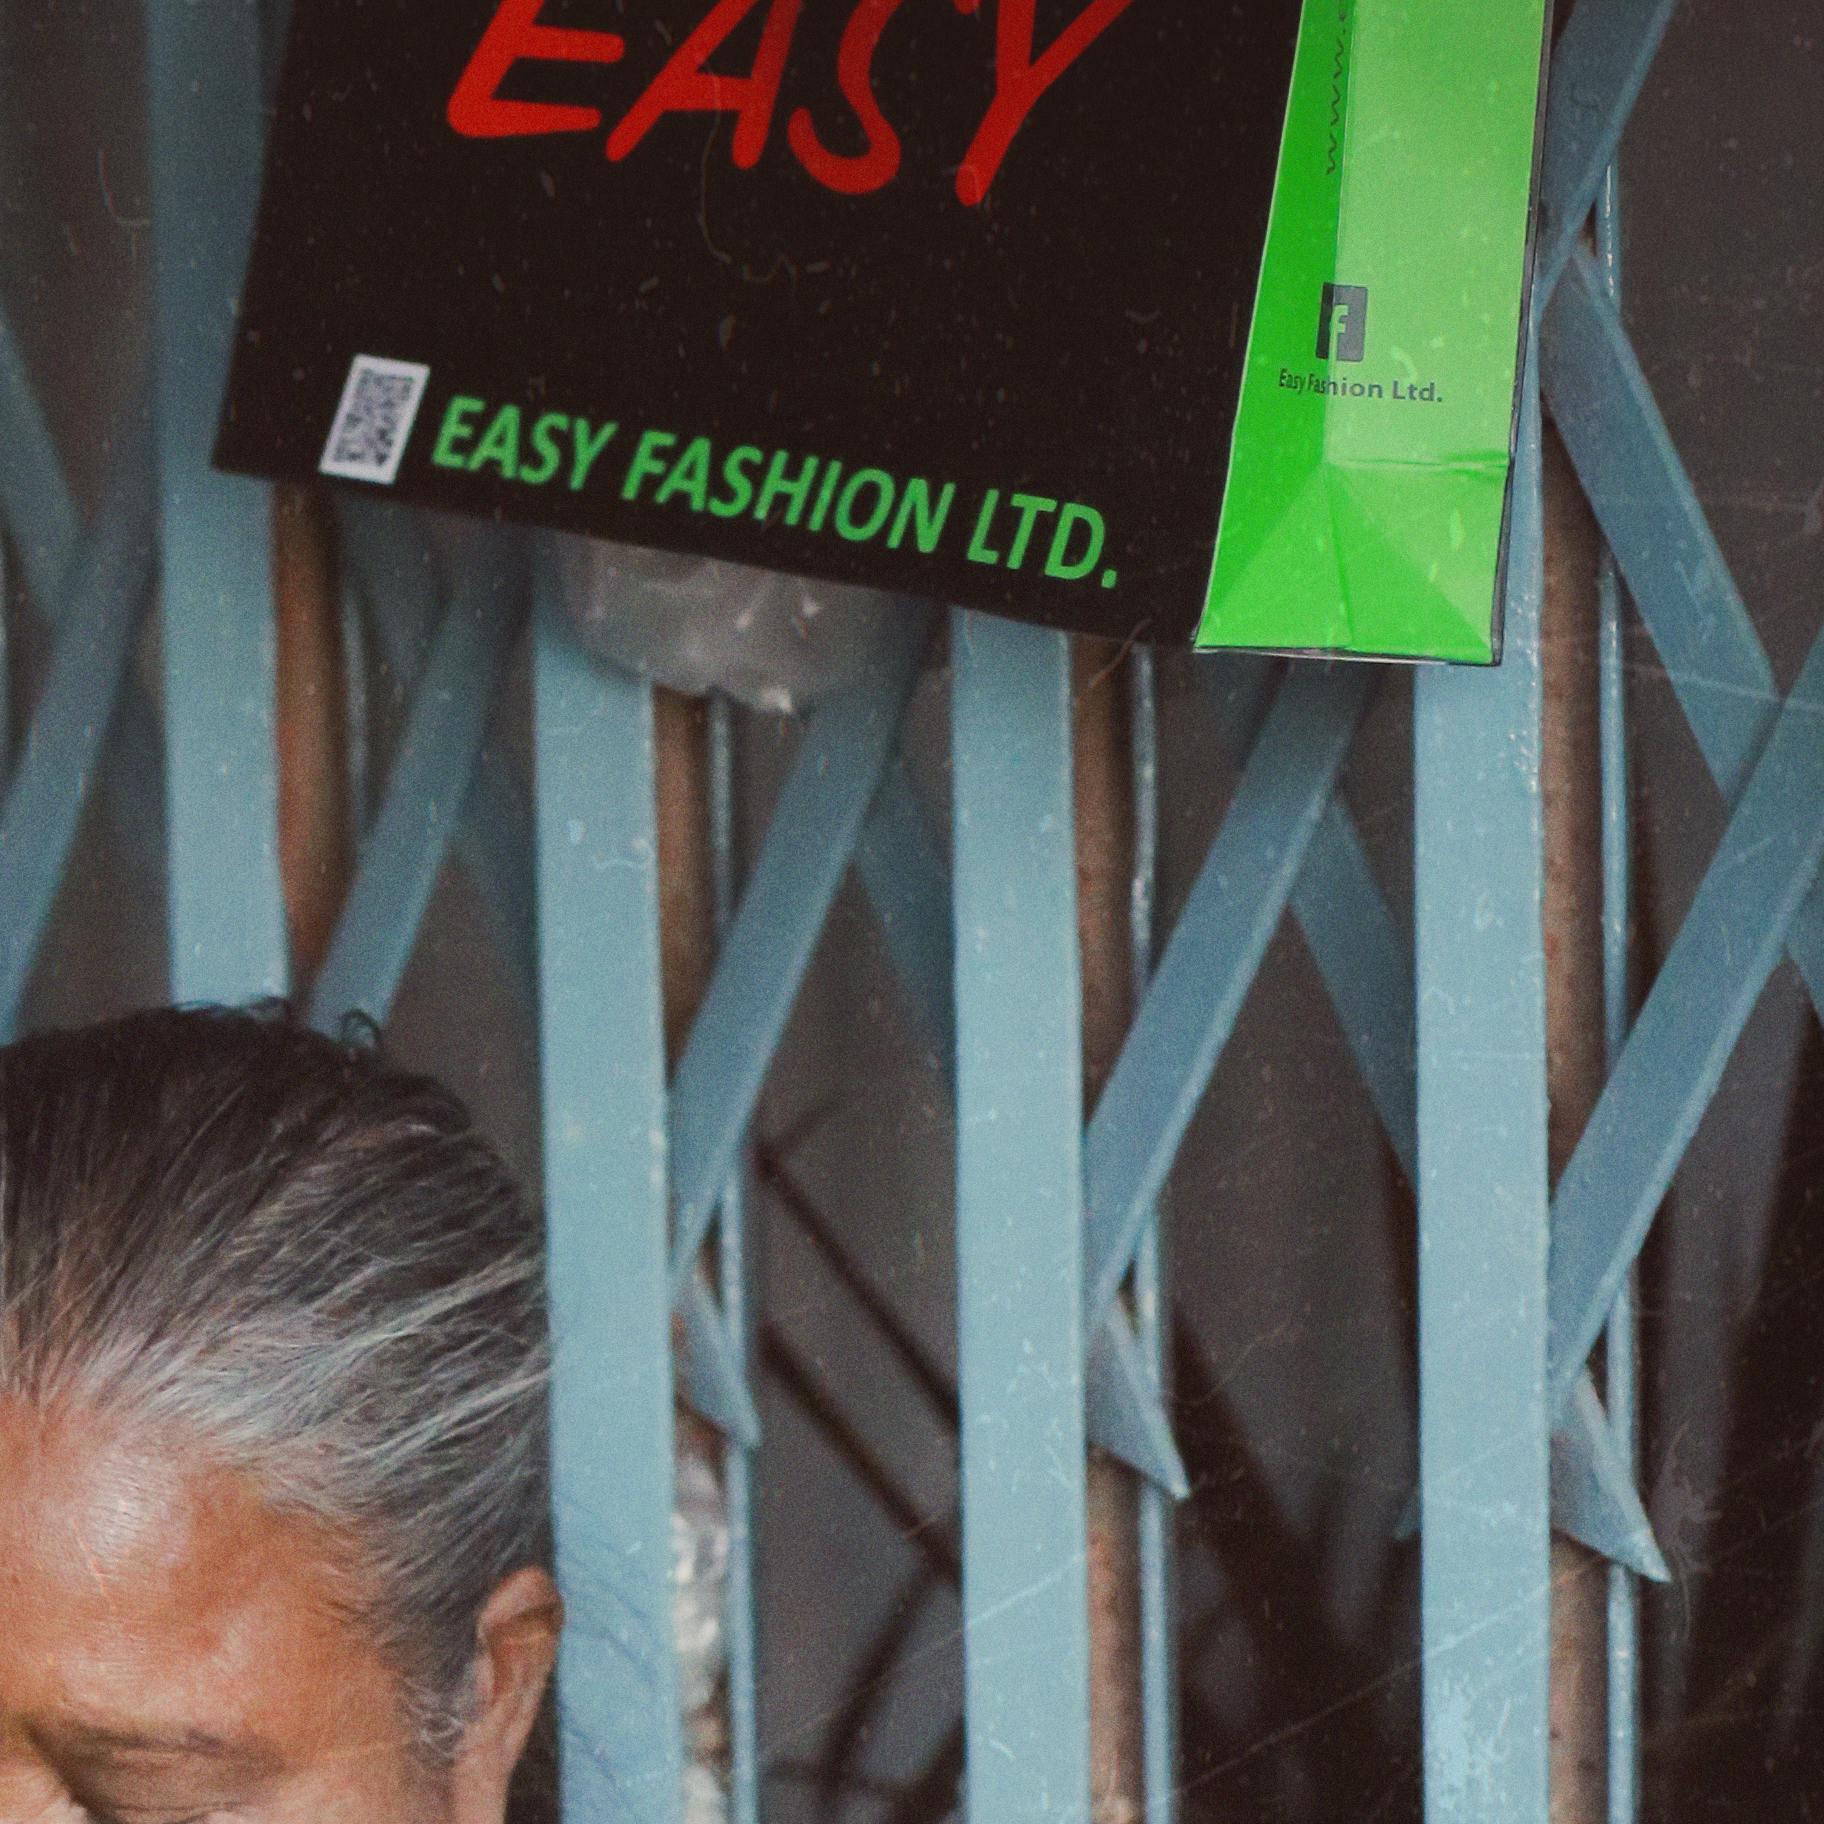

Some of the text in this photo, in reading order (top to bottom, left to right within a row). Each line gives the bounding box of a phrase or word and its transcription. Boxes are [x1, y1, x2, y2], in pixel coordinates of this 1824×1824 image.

[446, 0, 1134, 207] EASY
[1279, 367, 1443, 402] Easy Fashion Ltd.
[432, 394, 1118, 589] EASY FASHION LTD.
